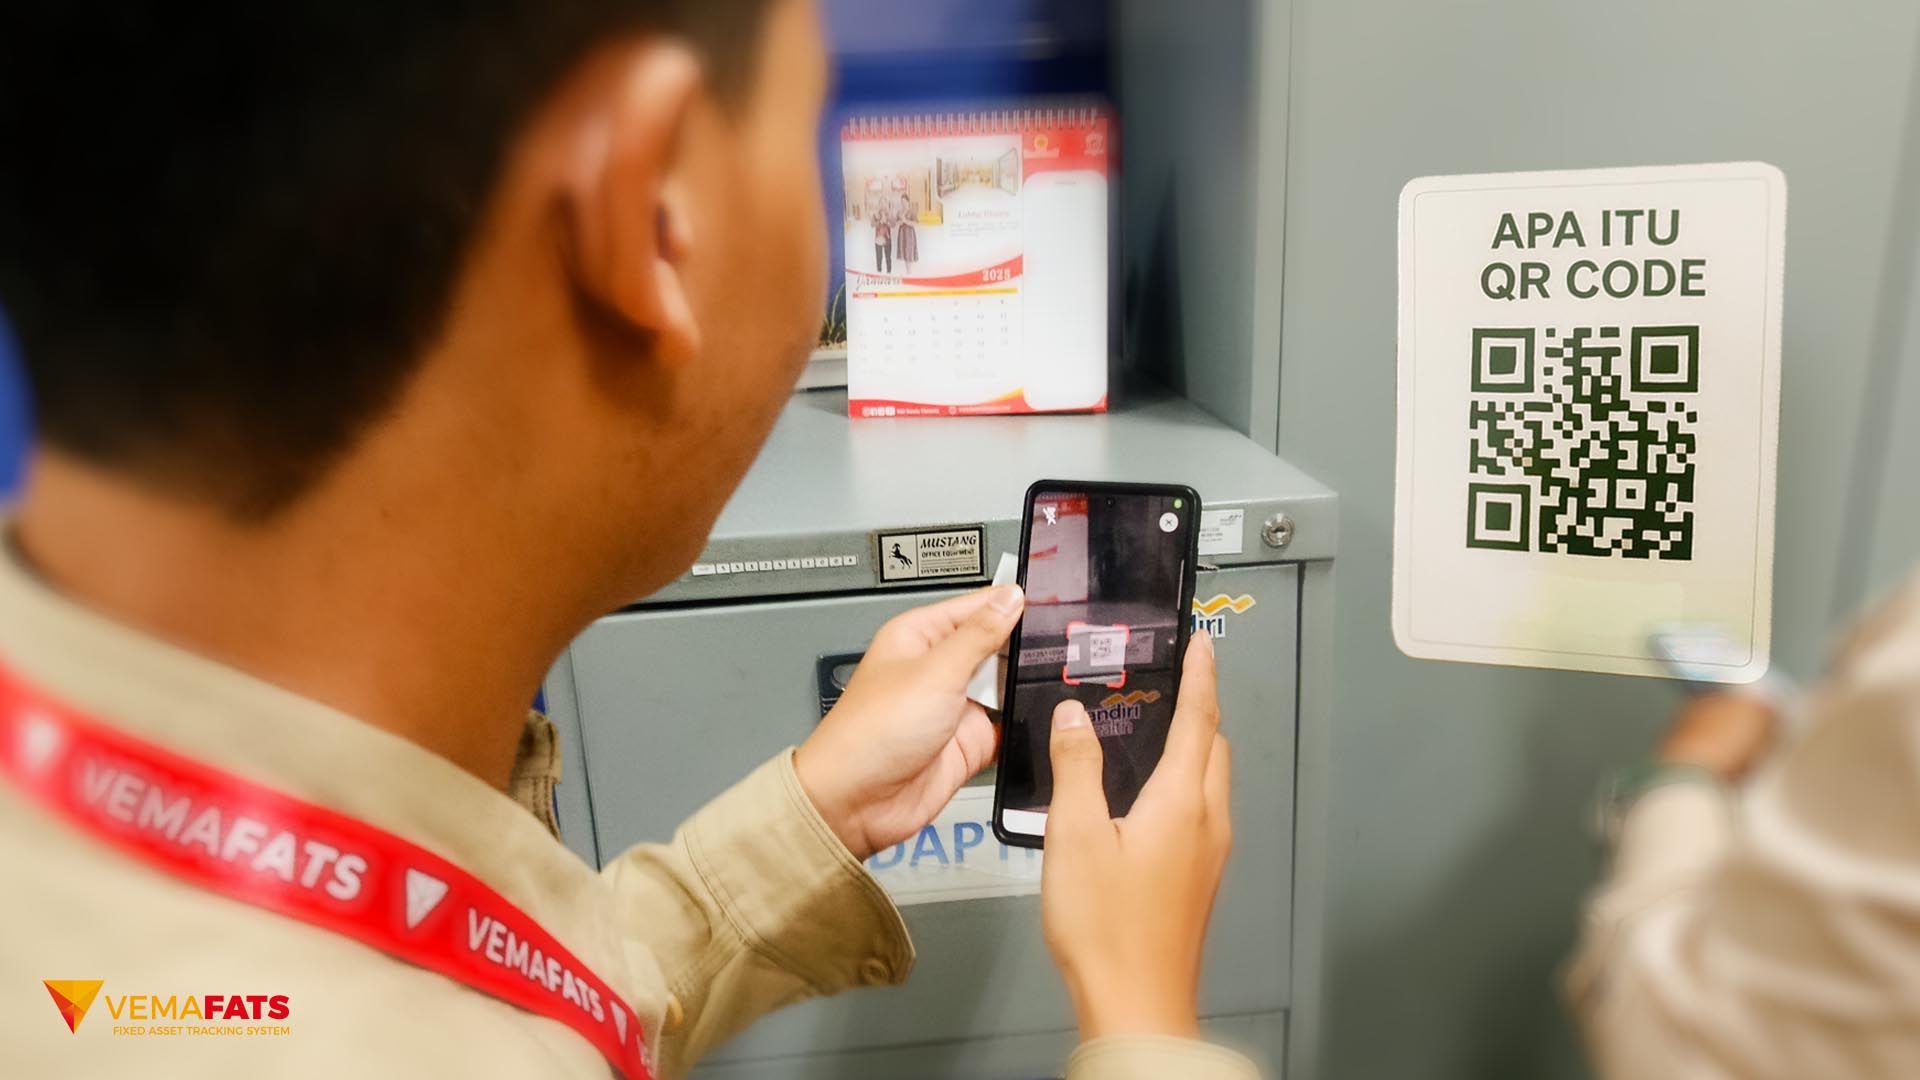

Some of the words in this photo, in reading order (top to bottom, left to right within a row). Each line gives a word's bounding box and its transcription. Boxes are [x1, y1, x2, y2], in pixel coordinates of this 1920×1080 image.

[1491, 211, 1586, 250] APA
[1601, 209, 1679, 246] ITU
[1481, 261, 1551, 301] QR
[1566, 258, 1706, 299] CODE
[920, 535, 977, 549] MUSTANG
[81, 757, 368, 901] VEMAFATS
[468, 907, 605, 1023] VEMAFATS
